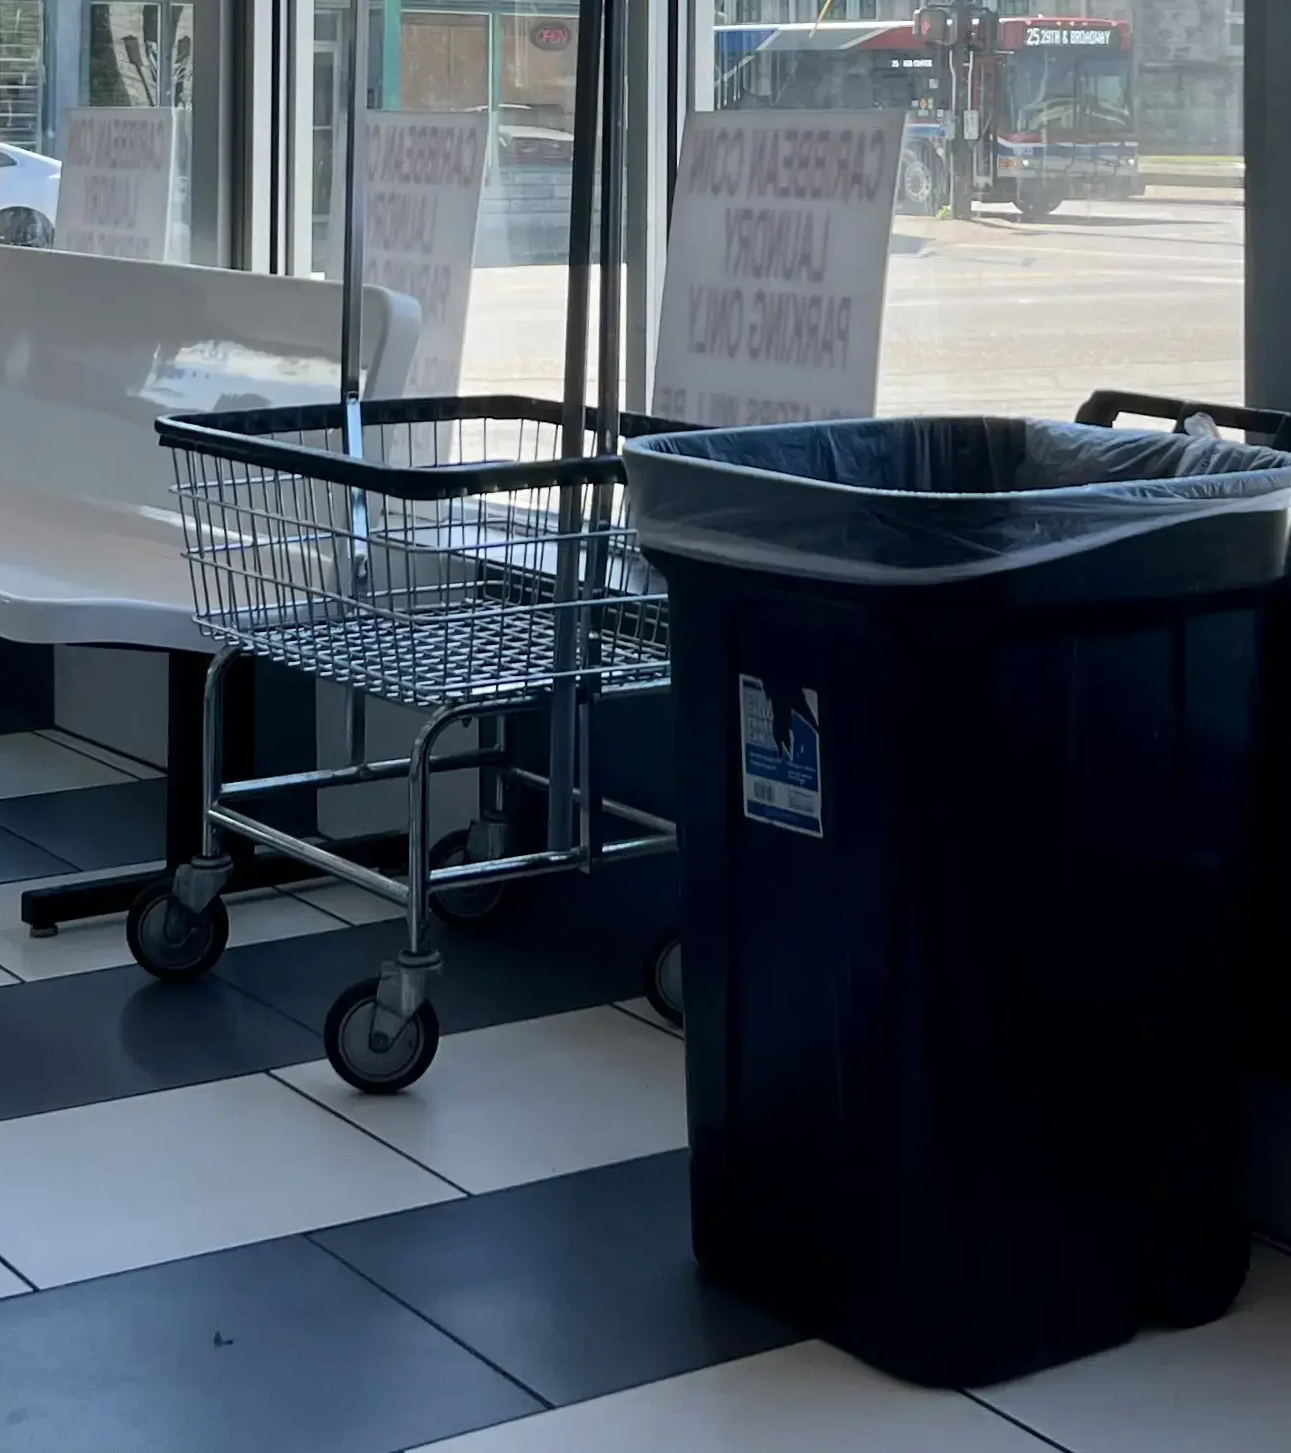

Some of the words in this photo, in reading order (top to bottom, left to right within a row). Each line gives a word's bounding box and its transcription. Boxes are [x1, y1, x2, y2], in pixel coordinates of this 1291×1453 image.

[1026, 28, 1040, 46] 25
[1041, 31, 1060, 45] 29TH
[1070, 30, 1111, 45] BROADWAY
